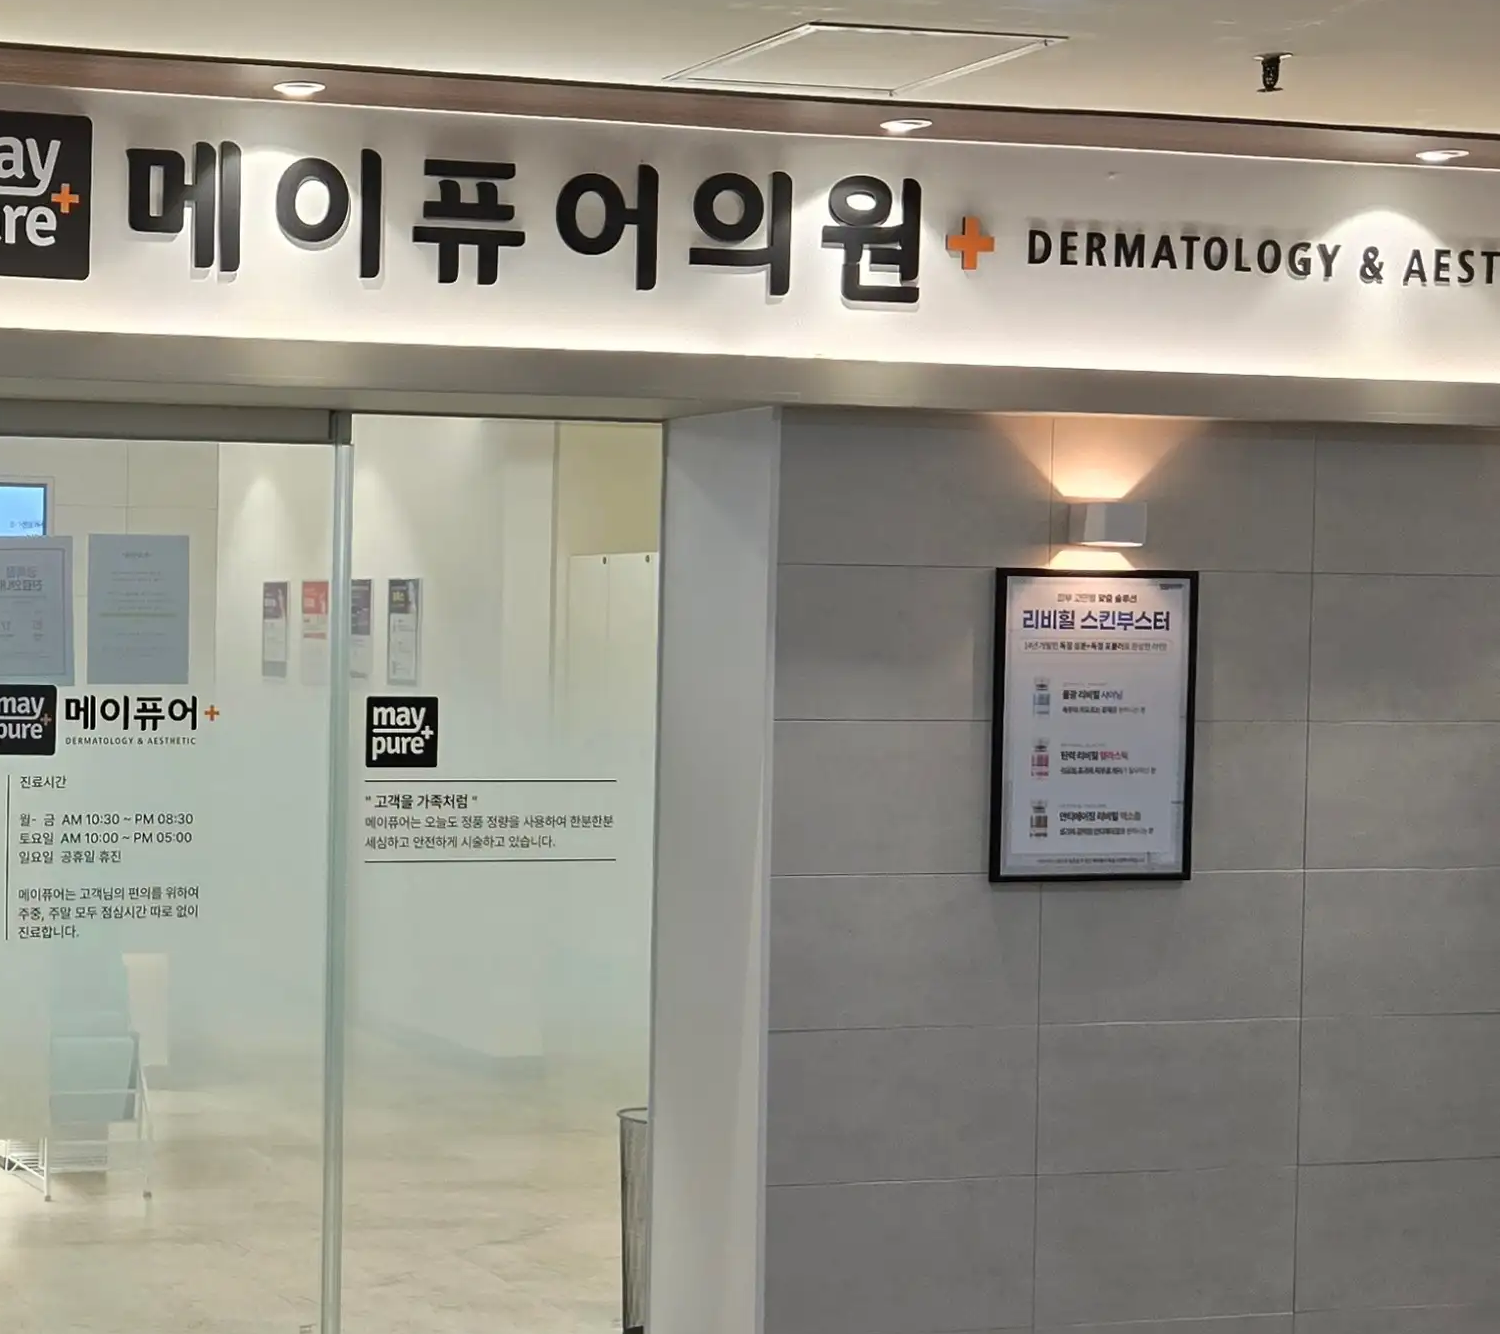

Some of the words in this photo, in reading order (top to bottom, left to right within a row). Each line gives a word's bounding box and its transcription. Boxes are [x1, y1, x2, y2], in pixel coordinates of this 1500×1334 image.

[126, 141, 921, 303] 메이퓨어의원
[1028, 229, 1342, 280] DERMATOLOGY
[1359, 245, 1383, 284] &
[1022, 609, 1075, 630] 리비힐
[1080, 610, 1171, 631] 스킨부스터
[65, 695, 198, 731] 메이퓨어
[372, 705, 426, 733] may
[65, 737, 134, 745] DERMATOLOGY
[147, 737, 196, 745] AESTHETIC
[372, 735, 425, 761] pure
[20, 776, 67, 789] 진료시간
[375, 794, 414, 809] 고객을
[417, 794, 468, 810] 가족처럼
[43, 813, 55, 827] 금
[62, 814, 82, 825] AM
[86, 813, 120, 825] 10:30
[135, 814, 154, 824] PM
[157, 813, 194, 825] 08:30
[365, 816, 421, 829] 메이퓨어는
[425, 816, 458, 829] 오늘도
[487, 815, 519, 829] 정량을
[524, 815, 567, 828] 사용하여
[570, 815, 613, 828] 한분한분
[19, 832, 54, 845] 토요일
[60, 833, 81, 844] AM
[85, 832, 119, 844] 10:00
[133, 832, 153, 843] PM
[156, 832, 192, 843] 05:00
[365, 836, 409, 850] 세심하고
[413, 836, 458, 849] 안전하게
[461, 835, 504, 848] 시술하고
[508, 835, 556, 848] 있습니다.
[18, 851, 54, 864] 일요일
[61, 850, 95, 864] 공휴일
[99, 850, 122, 864] 휴진
[18, 887, 76, 901] 메이퓨어는
[79, 887, 125, 901] 고객님의
[128, 886, 162, 900] 편의를
[165, 886, 200, 900] 위하여
[18, 907, 45, 922] 주중,
[49, 906, 71, 920] 주말
[75, 906, 97, 920] 모두
[101, 905, 147, 920] 점심시간
[150, 905, 173, 919] 따로
[176, 905, 198, 918] 없이
[18, 925, 80, 939] 진료합니다.
